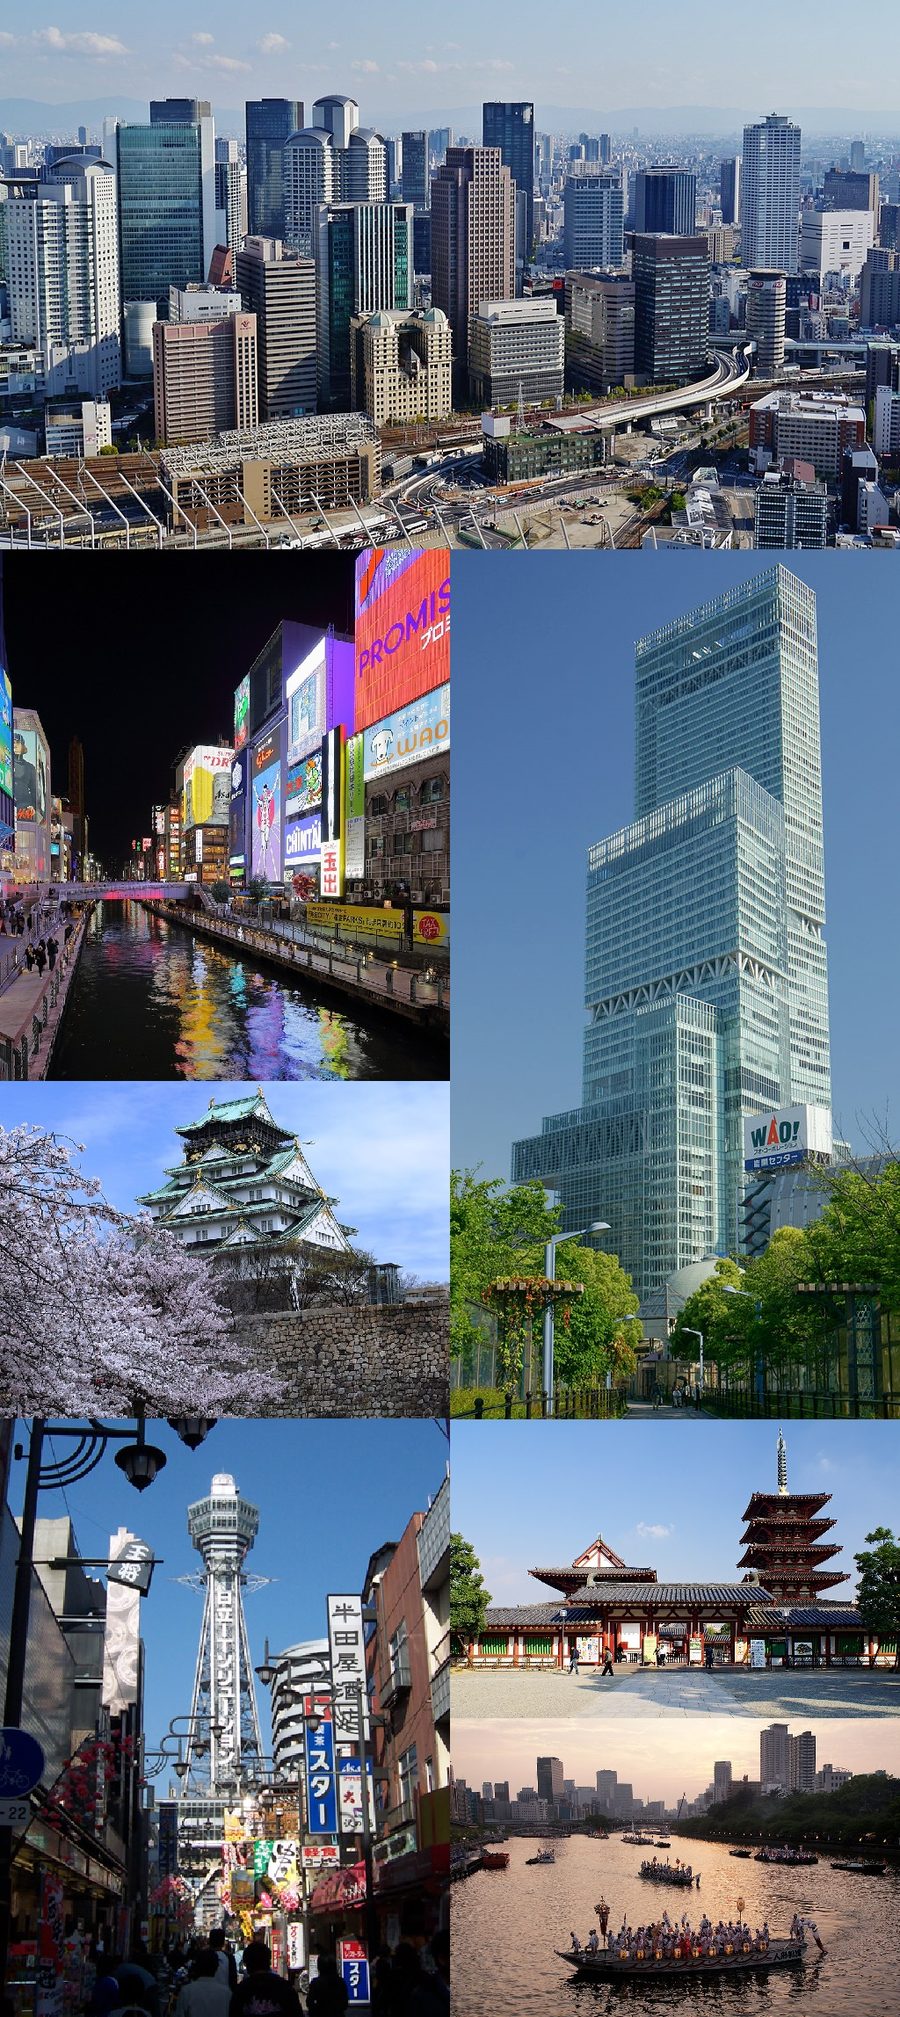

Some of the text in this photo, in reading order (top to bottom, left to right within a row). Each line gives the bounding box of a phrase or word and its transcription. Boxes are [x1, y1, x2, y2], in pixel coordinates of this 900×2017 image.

[397, 719, 448, 756] WAO
[323, 852, 337, 893] 玉出
[750, 1114, 800, 1148] WAO!
[342, 1762, 370, 1773] Asai
[310, 1750, 330, 1825] スター
[350, 1962, 360, 1998] スター
